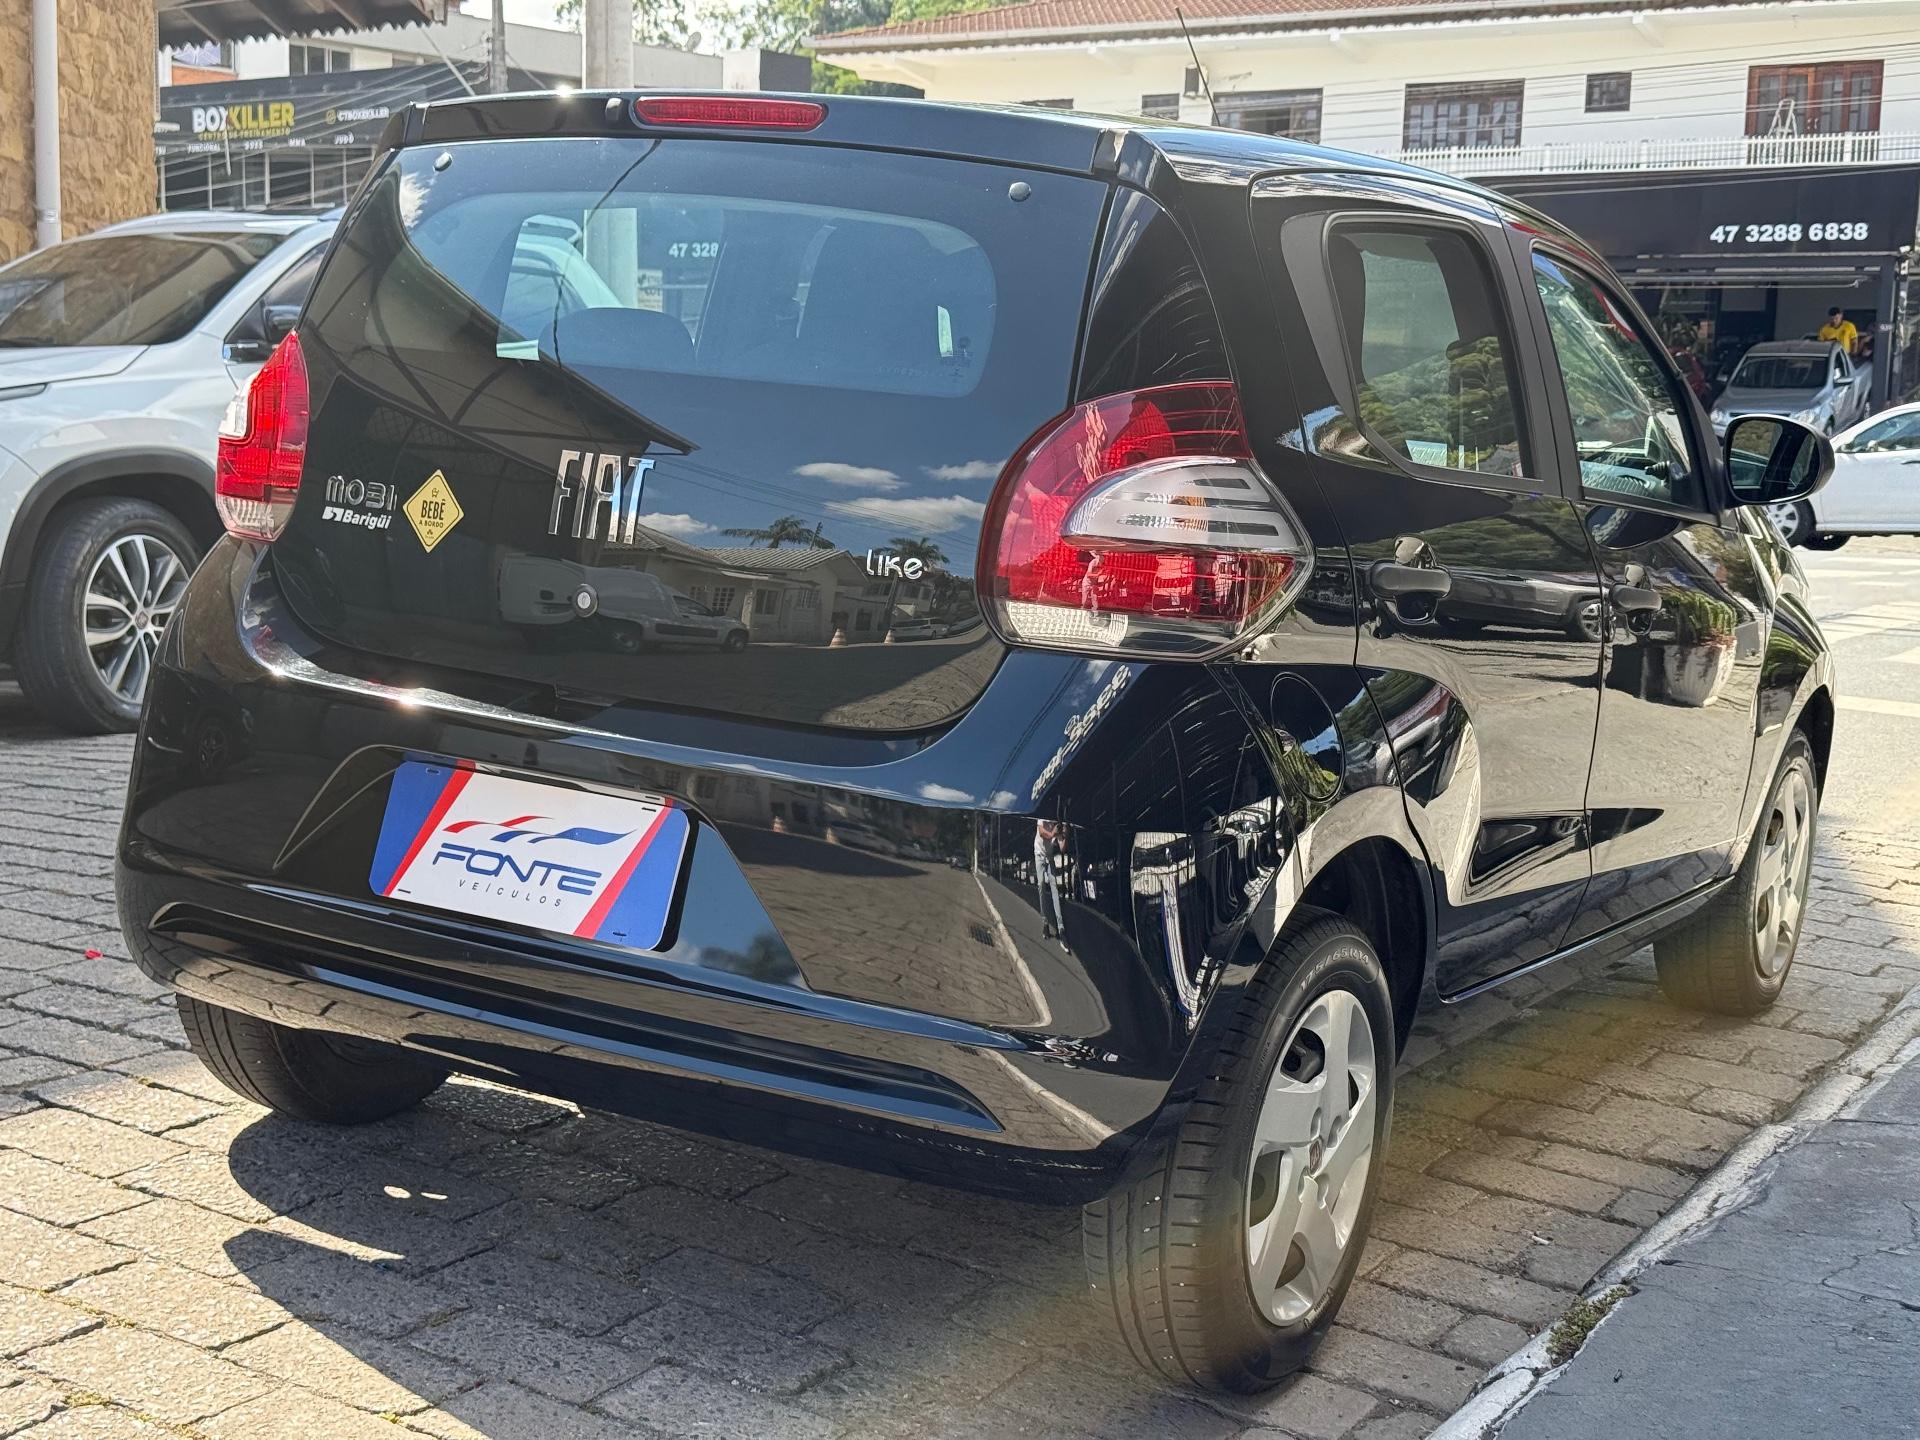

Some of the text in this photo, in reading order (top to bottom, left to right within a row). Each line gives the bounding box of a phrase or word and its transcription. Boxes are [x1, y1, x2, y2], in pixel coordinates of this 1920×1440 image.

[1709, 222, 1870, 243] 47 3288 6838
[668, 242, 689, 258] 47
[548, 449, 656, 545] FIAT
[342, 509, 392, 530] Barigüi
[420, 498, 446, 521] BEBÊ
[418, 519, 444, 529] A BORDO
[432, 842, 602, 896] FONTE
[458, 878, 562, 908] VEÍCULOS
